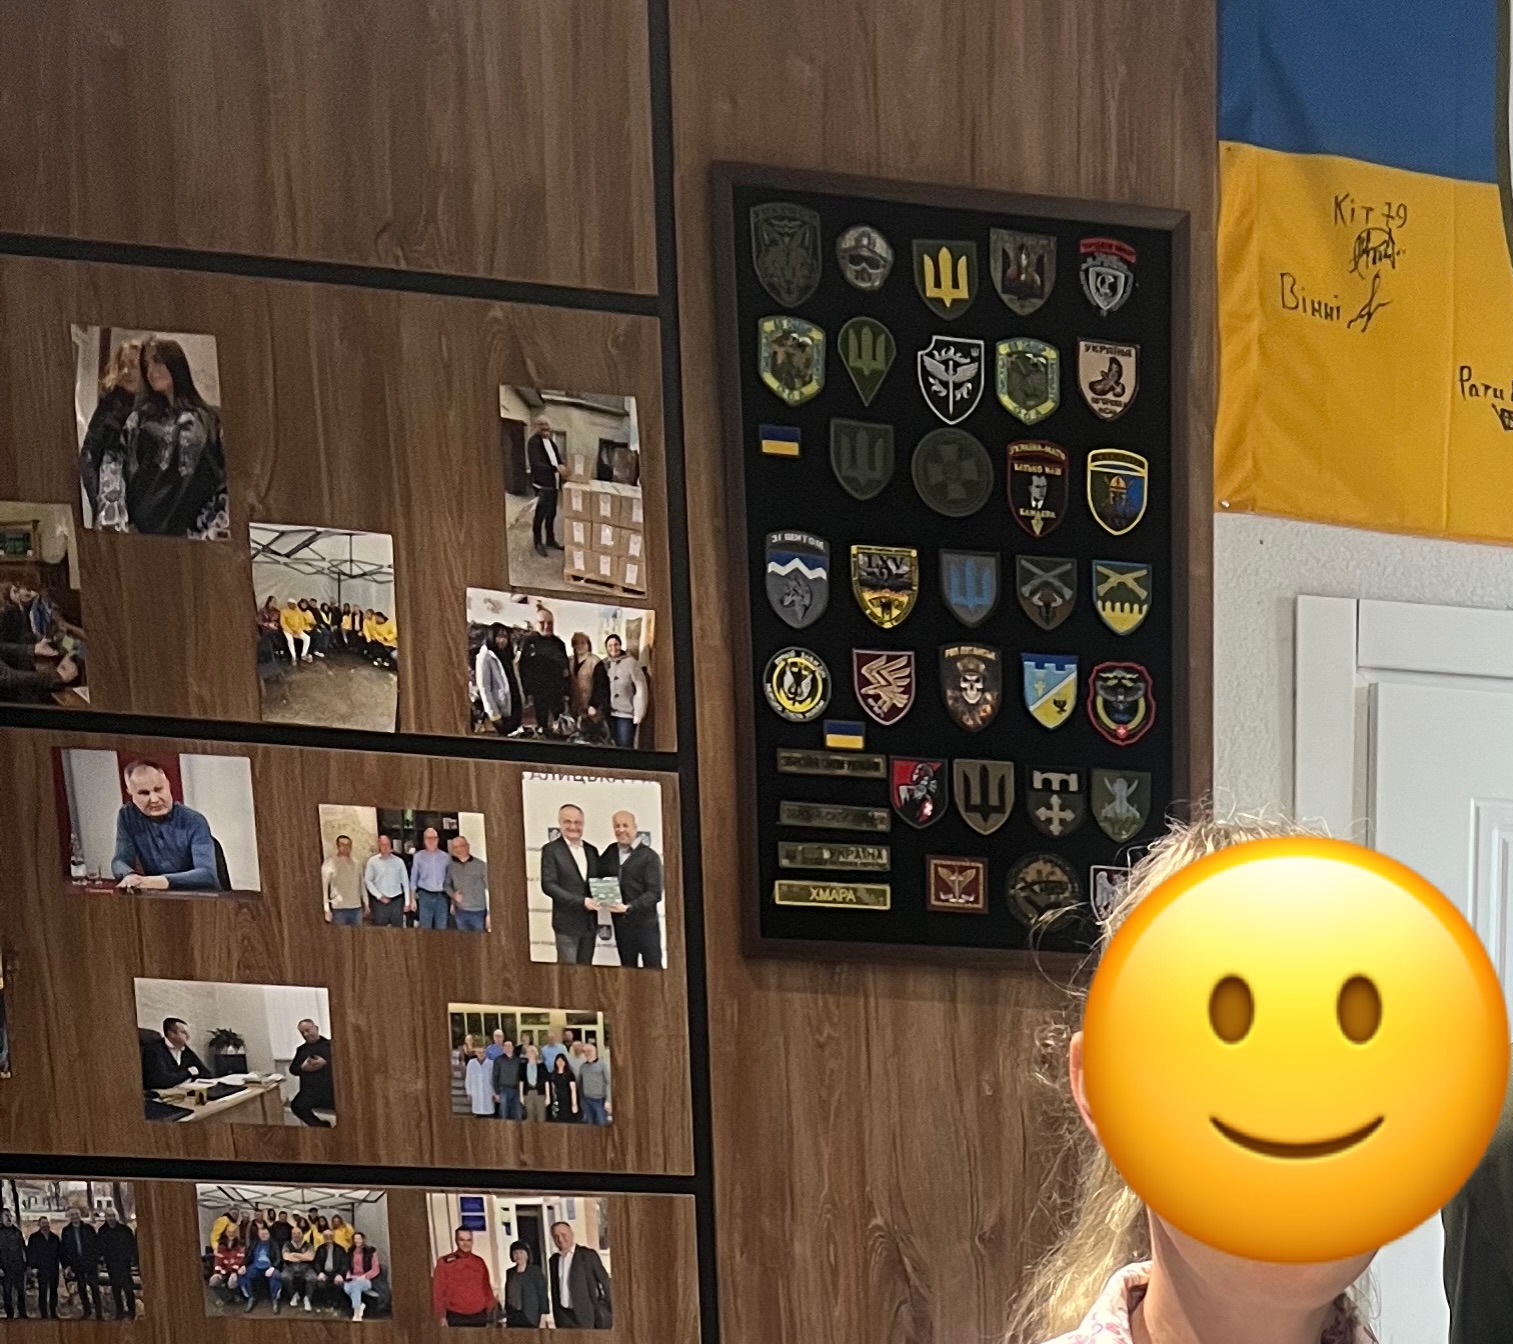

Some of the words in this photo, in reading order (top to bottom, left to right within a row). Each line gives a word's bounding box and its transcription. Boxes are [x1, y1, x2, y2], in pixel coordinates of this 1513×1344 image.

[1333, 192, 1375, 228] Кіт
[1382, 201, 1408, 229] 79
[1280, 272, 1342, 321] Вінні
[809, 886, 857, 903] ХМАРА
